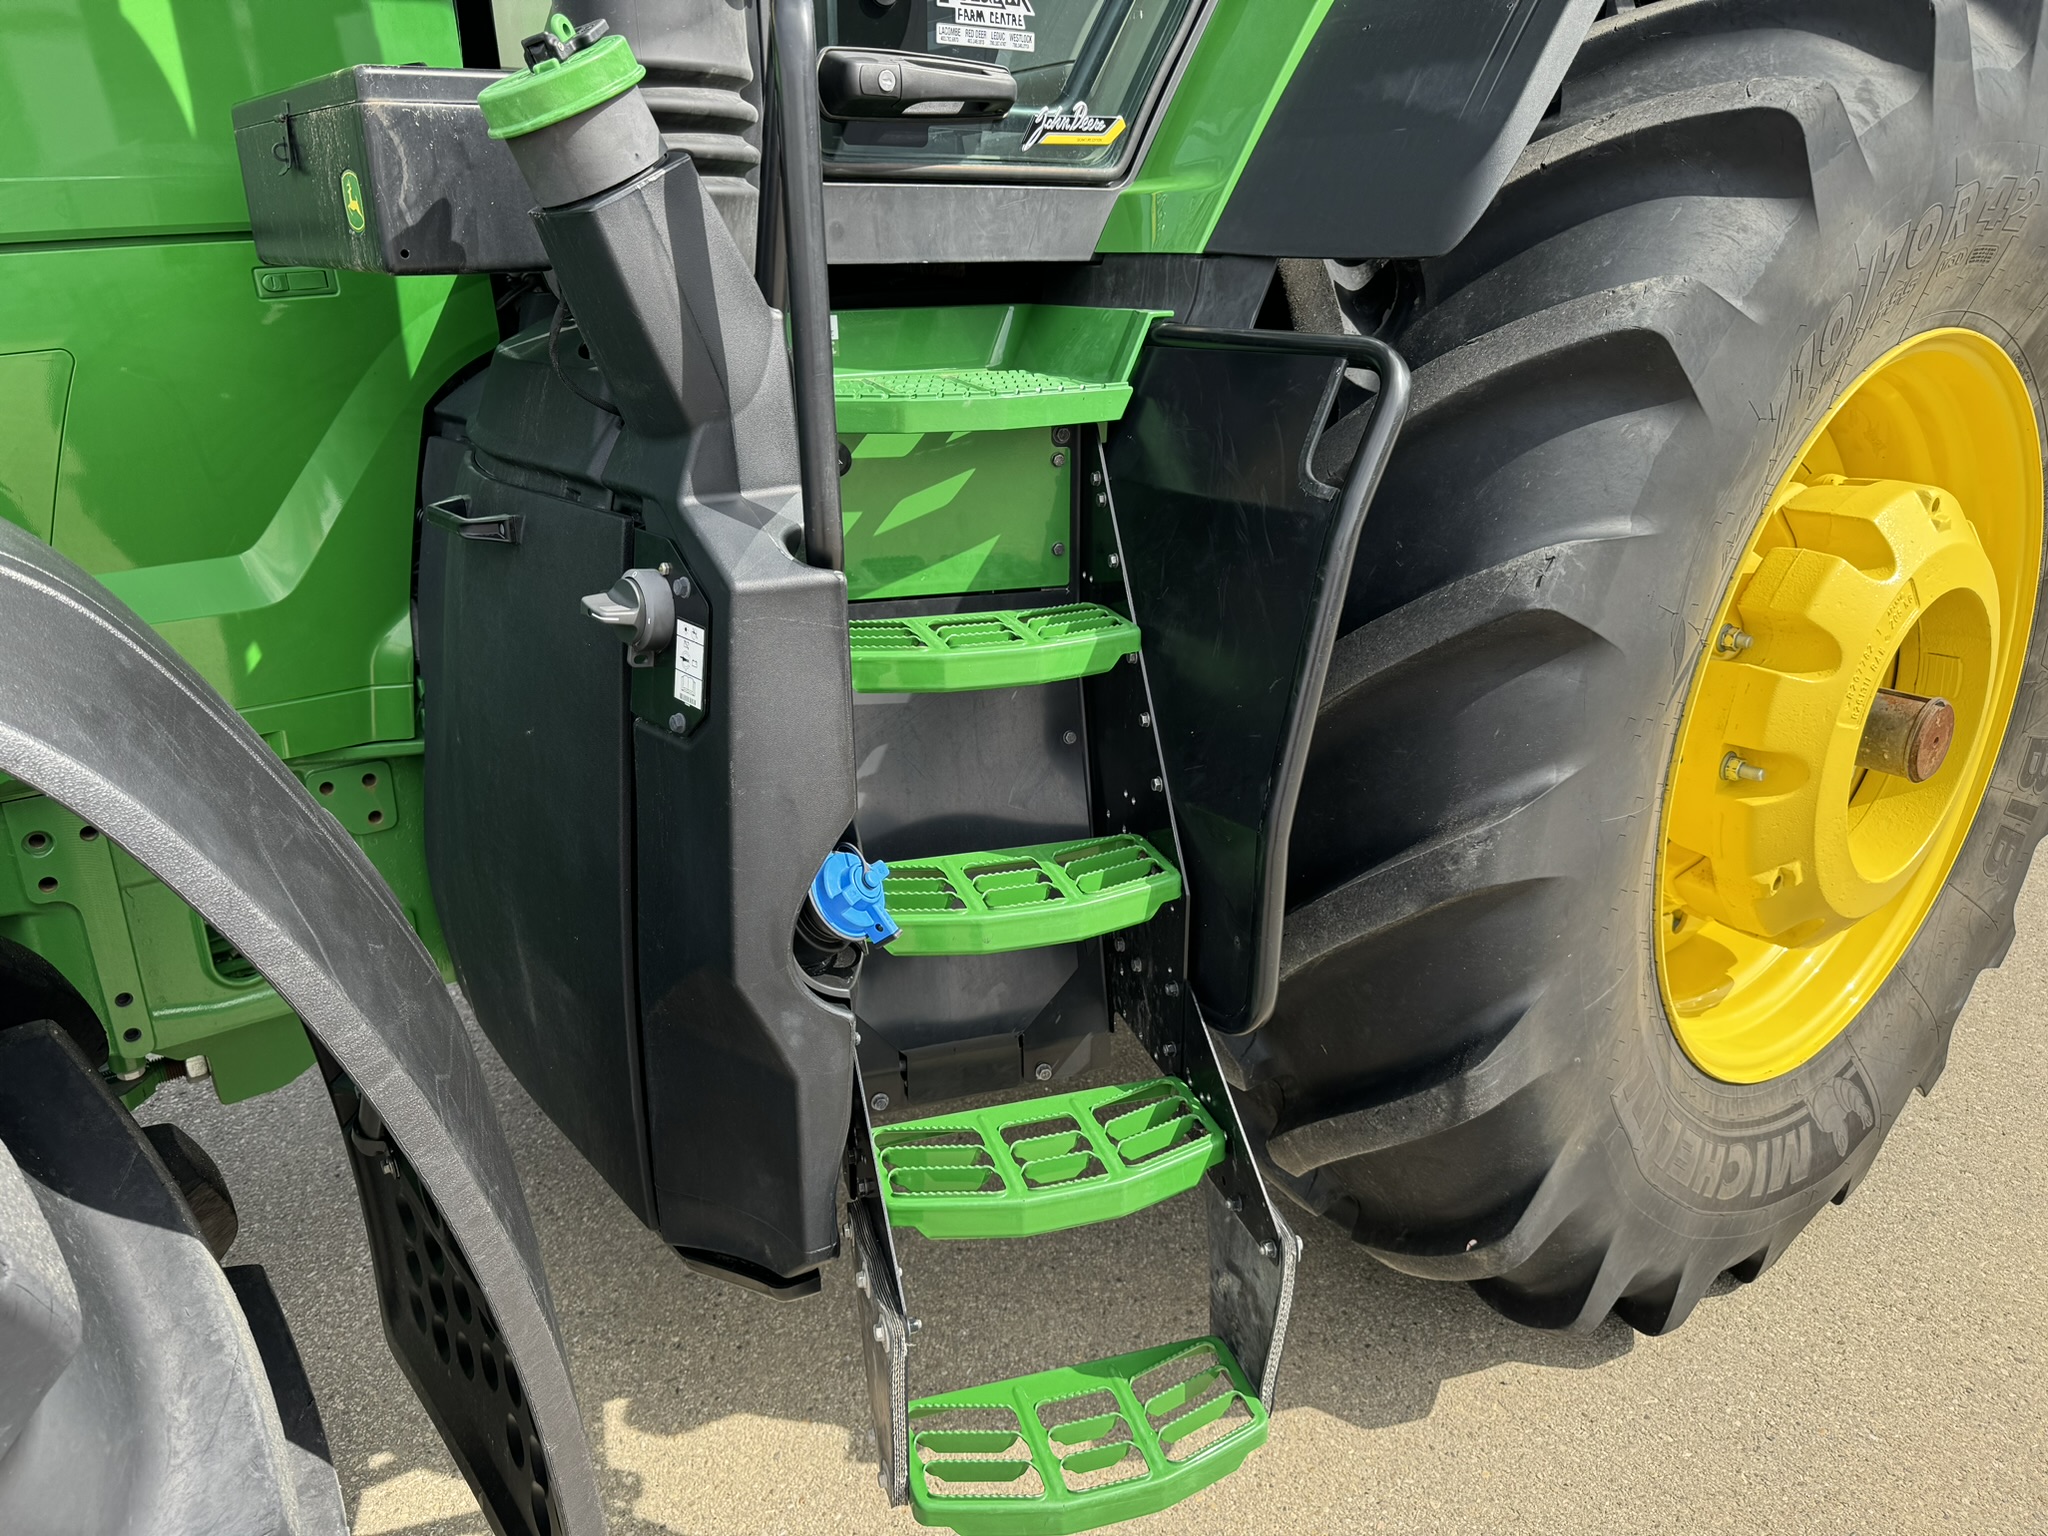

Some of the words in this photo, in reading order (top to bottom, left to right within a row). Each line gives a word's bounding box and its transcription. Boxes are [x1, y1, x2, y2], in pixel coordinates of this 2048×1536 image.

[957, 8, 986, 23] FARM
[989, 12, 1024, 27] CENTRE
[939, 26, 961, 37] LACOMBE
[965, 28, 974, 38] RED
[975, 29, 987, 39] DEER
[991, 31, 1006, 41] LEDUC
[1009, 33, 1033, 44] WESTLOCK
[1022, 105, 1072, 152] John
[1069, 101, 1107, 132] Deere
